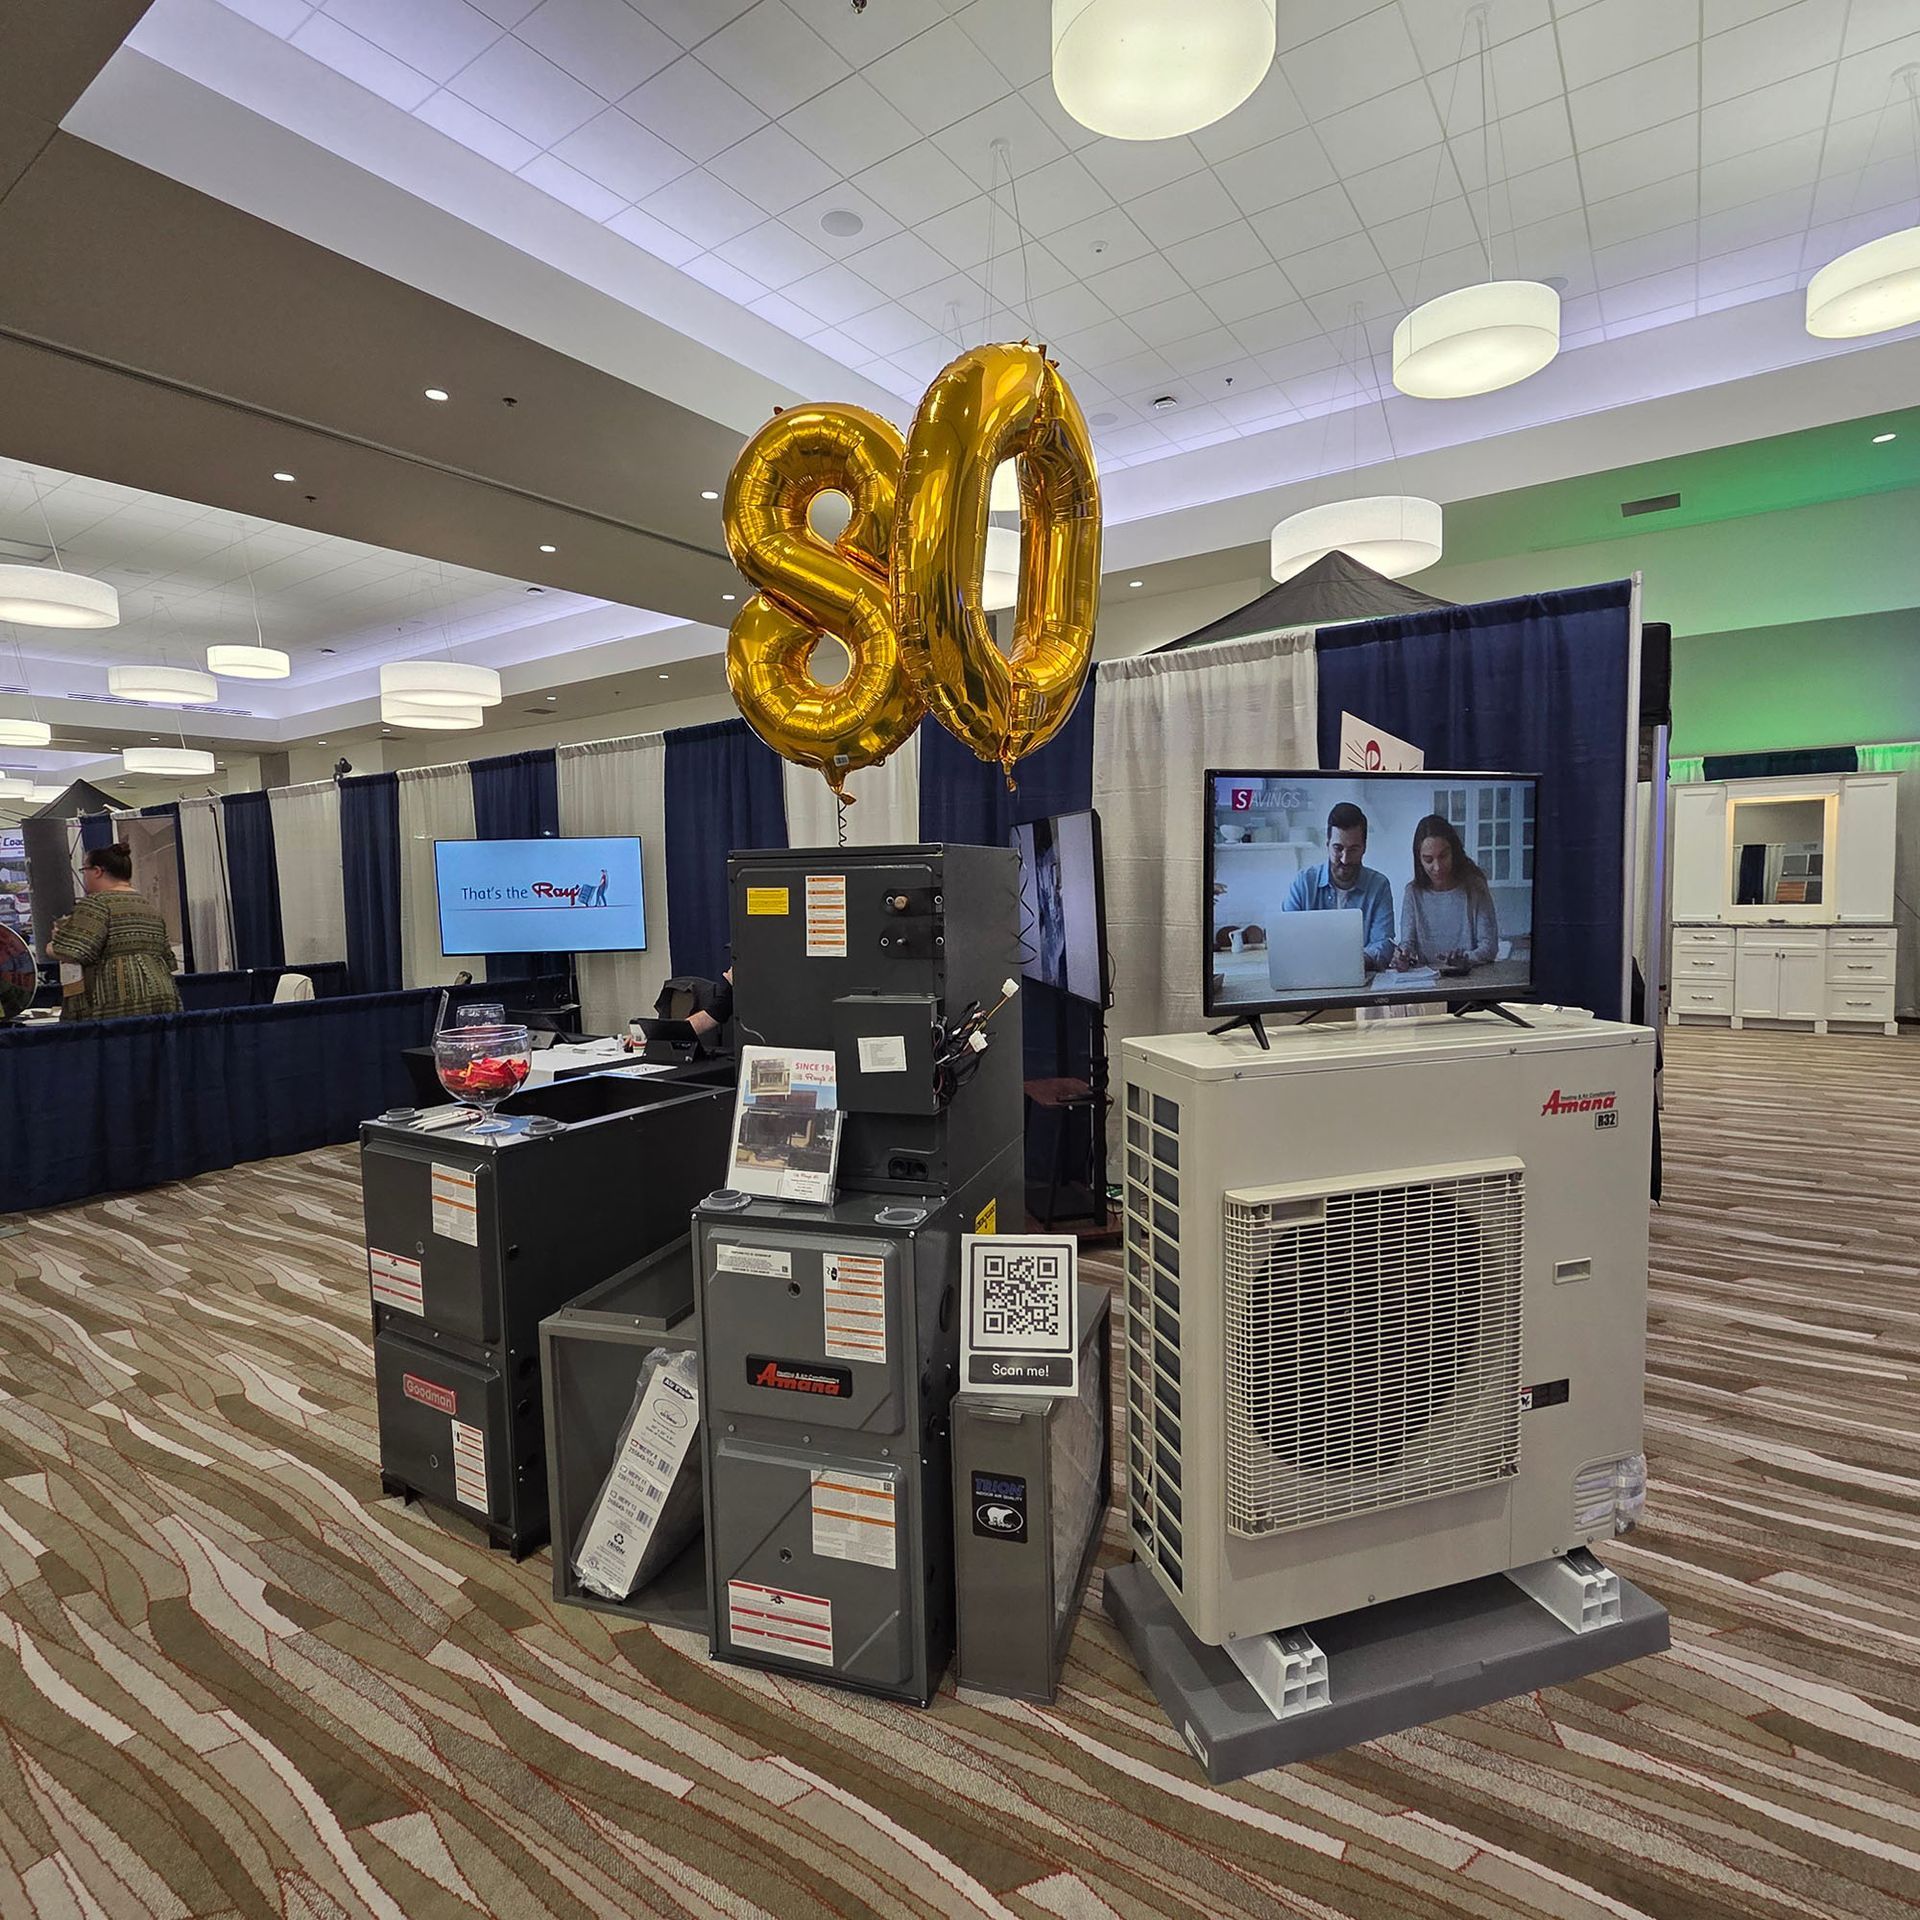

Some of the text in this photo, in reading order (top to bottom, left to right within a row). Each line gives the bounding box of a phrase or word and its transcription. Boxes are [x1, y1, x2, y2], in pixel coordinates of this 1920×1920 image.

[1236, 791, 1300, 809] SAVINGS
[462, 886, 502, 900] That's
[506, 887, 528, 899] the
[795, 1062, 820, 1071] SINCE
[1541, 1089, 1617, 1116] Amana
[756, 1363, 840, 1395] Amana
[992, 1363, 1050, 1377] Scan me!
[406, 1380, 453, 1408] Goodman
[975, 1478, 1024, 1497] TRION
